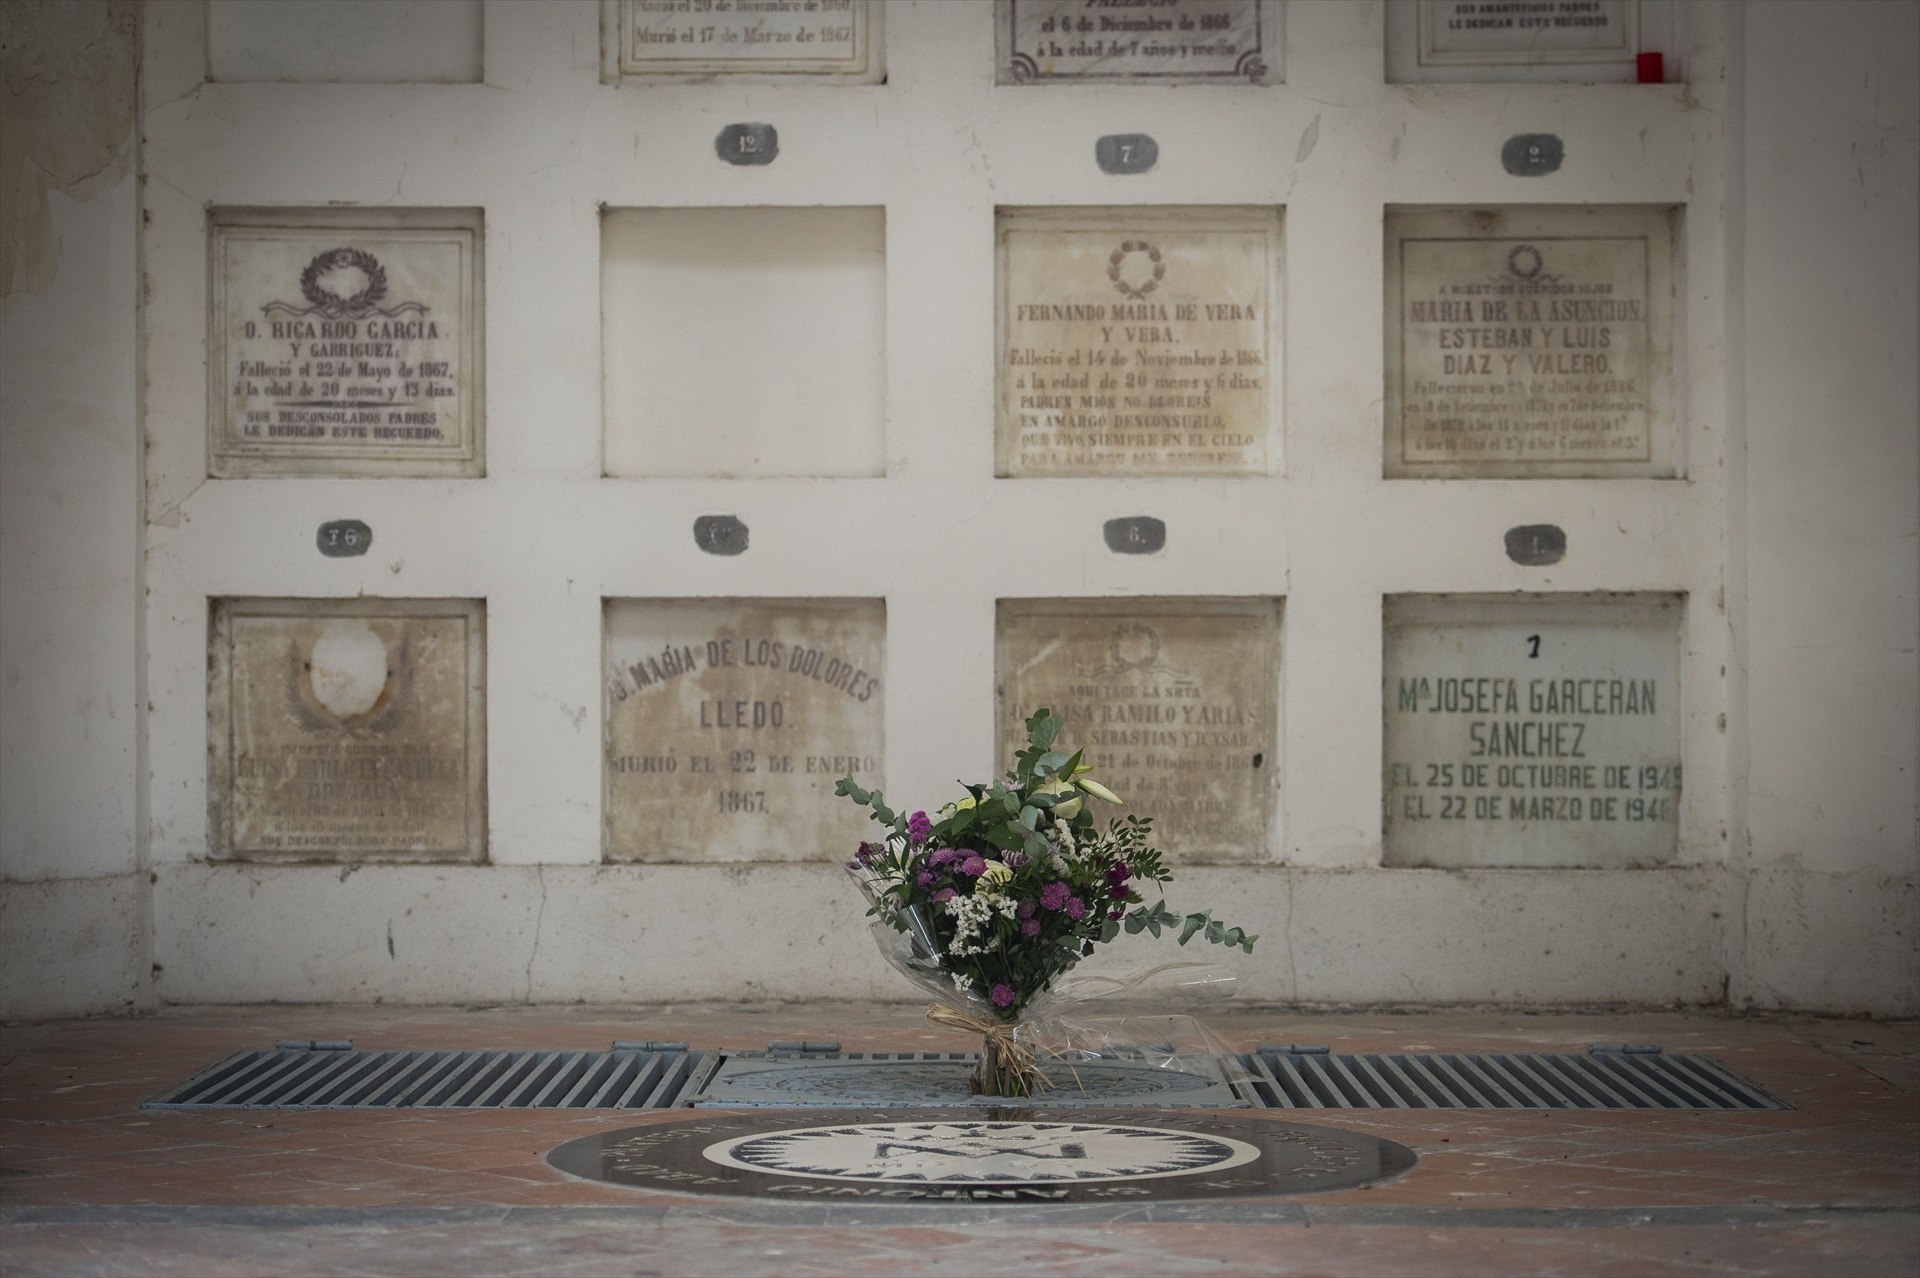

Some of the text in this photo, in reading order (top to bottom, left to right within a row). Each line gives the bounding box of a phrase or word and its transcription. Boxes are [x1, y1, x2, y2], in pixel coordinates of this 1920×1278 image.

[1041, 16, 1054, 32] el
[1077, 16, 1093, 32] de
[1101, 15, 1173, 32] Diciembre
[1179, 15, 1195, 31] de
[681, 26, 693, 42] el
[700, 26, 714, 43] 17
[721, 26, 738, 43] de
[743, 26, 792, 43] Marzo
[796, 26, 815, 43] de
[1050, 41, 1063, 57] la
[1069, 41, 1102, 57] edad
[1016, 303, 1257, 321] FERNANDO MARIA DE VERA
[1410, 300, 1475, 323] MARIA
[1482, 300, 1508, 323] DE
[1516, 300, 1542, 323] LA
[271, 321, 358, 340] RICARDO
[366, 320, 439, 340] GARCIA
[1101, 326, 1113, 343] Y
[1440, 326, 1612, 349] ESTEBAN Y LUIS
[290, 342, 301, 359] Y
[1067, 349, 1081, 366] el
[1110, 349, 1128, 366] de
[1135, 348, 1216, 367] Noviembre
[239, 360, 292, 378] Falleció
[299, 361, 310, 378] el
[316, 361, 333, 378] 22
[338, 361, 352, 378] de
[358, 361, 391, 382] Mayo
[398, 361, 413, 378] de
[1443, 354, 1492, 375] DIAZ
[1502, 354, 1517, 375] Y
[1031, 371, 1046, 389] la
[1052, 371, 1089, 389] edad
[1099, 371, 1118, 389] de
[1124, 371, 1148, 389] 20
[264, 380, 292, 397] edad
[299, 380, 314, 397] de
[321, 381, 340, 397] 20
[346, 385, 383, 397] meses
[387, 386, 398, 401] y
[1020, 395, 1072, 409] PADRES
[246, 411, 437, 426] SUS DESCONSOLADOS PADRES
[1020, 414, 1039, 428] EN
[1044, 414, 1107, 429] AMARGO
[268, 425, 325, 439] DEDICAN
[332, 425, 367, 440] ESTE
[1088, 433, 1157, 448] SIEMPRE
[1162, 433, 1183, 447] EN
[1188, 433, 1208, 447] EL
[1211, 432, 1255, 448] CIELO
[706, 639, 733, 669] DE
[744, 638, 784, 670] LOS
[788, 644, 881, 703] DOLORES
[1429, 676, 1519, 714] JOSEFA
[1529, 677, 1657, 716] GARCERAN
[1181, 705, 1195, 724] Y
[1199, 705, 1257, 725] ARIAS
[1091, 731, 1177, 747] SEBASTIAN
[1469, 721, 1587, 758] SANCHEZ
[690, 756, 715, 774] EL
[729, 749, 757, 774] 22
[768, 755, 795, 774] DE
[804, 755, 876, 774] ENERO
[1391, 762, 1418, 787] EL
[1426, 763, 1454, 788] 25
[1461, 763, 1489, 788] DE
[1497, 764, 1597, 789] OCTUBRE
[1604, 764, 1632, 789] DE
[1403, 796, 1431, 820] EL
[1440, 796, 1467, 819] 22
[1475, 796, 1502, 820] DE
[1509, 797, 1582, 821] MARZO
[1590, 797, 1618, 821] DE
[766, 1185, 1071, 1199] ANTONIO
